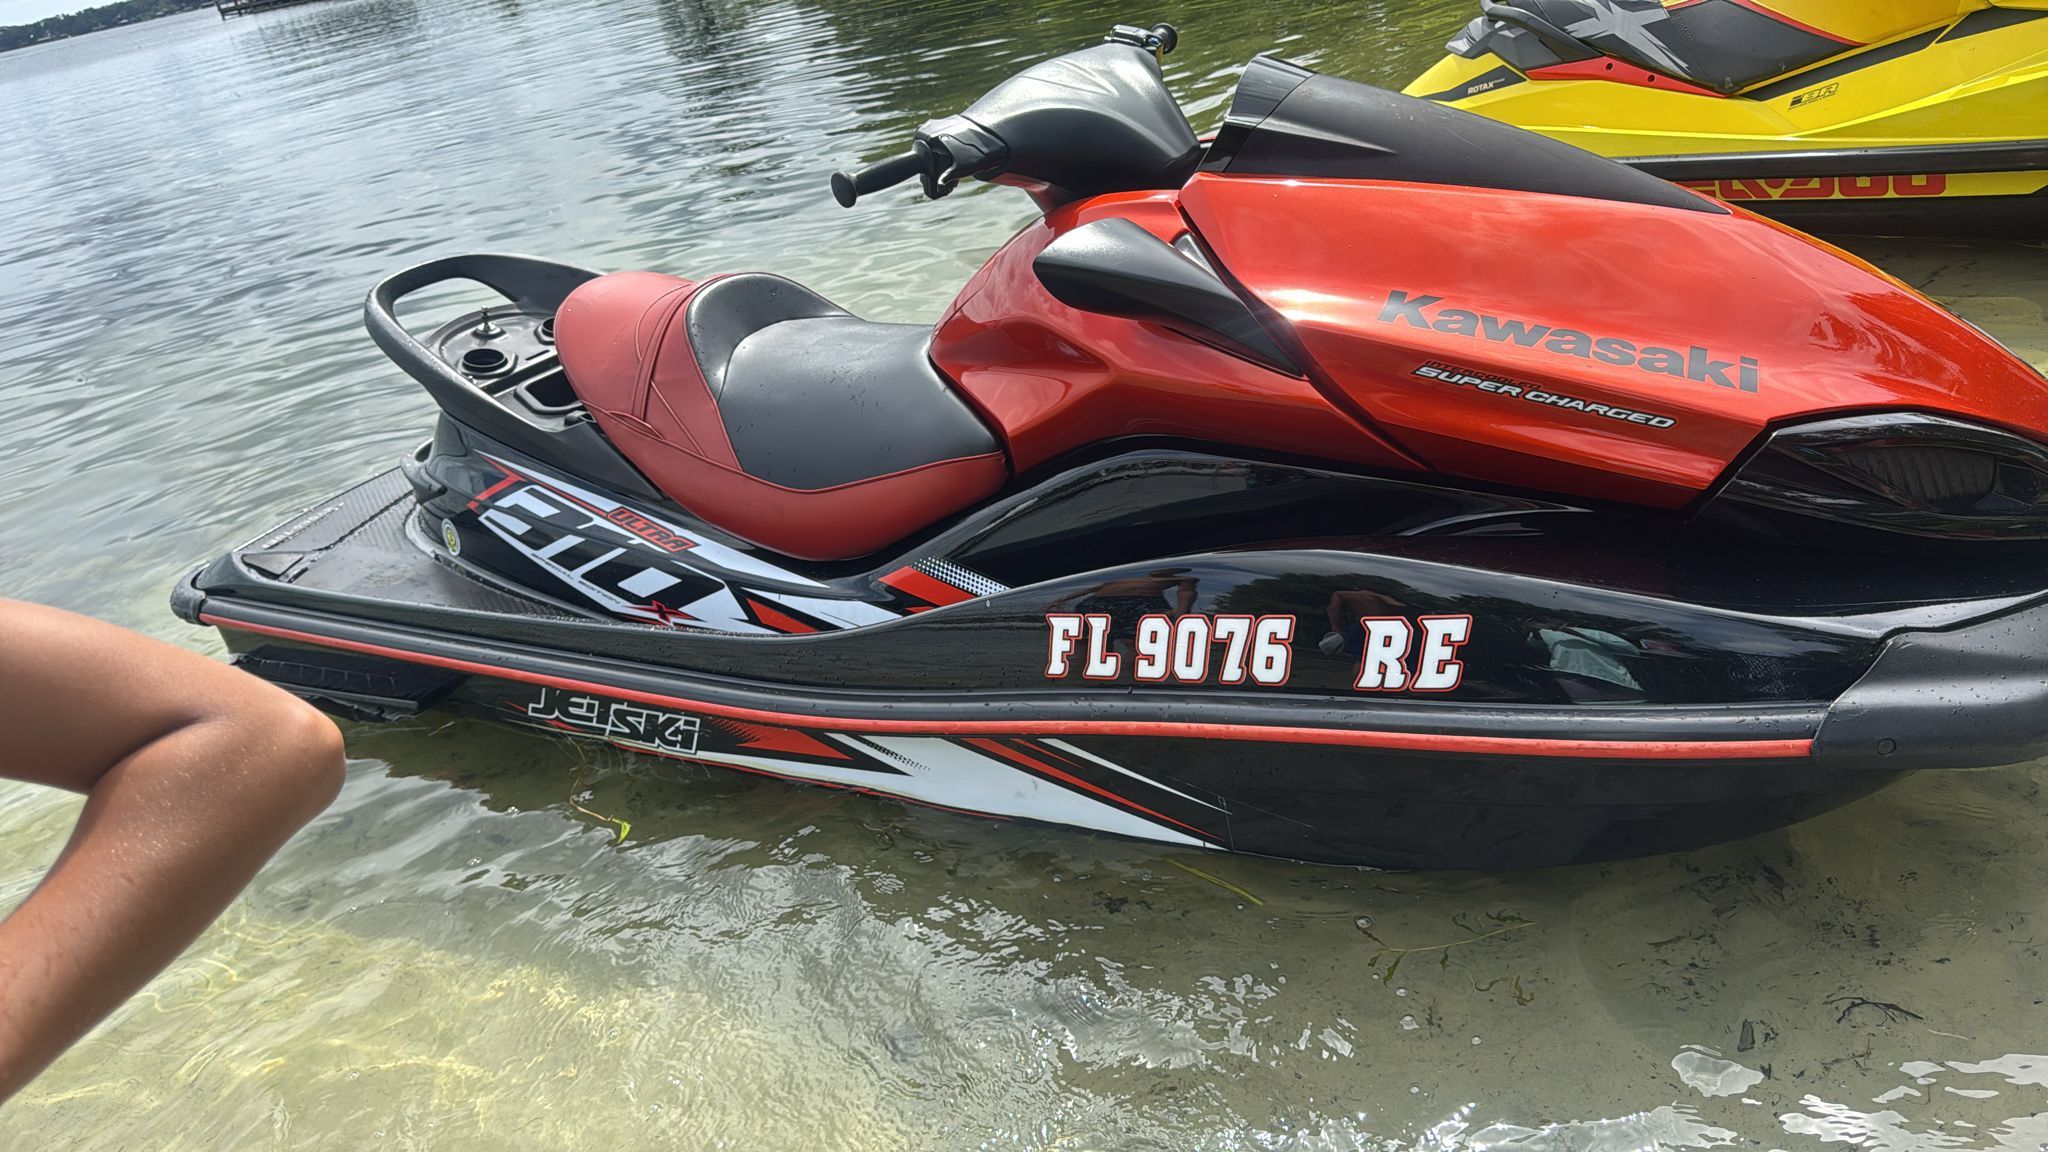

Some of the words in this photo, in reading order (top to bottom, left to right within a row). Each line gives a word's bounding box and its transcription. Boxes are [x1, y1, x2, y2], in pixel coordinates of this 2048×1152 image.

[1467, 80, 1495, 95] ROTAX
[1377, 289, 1760, 394] Kawasaki
[1415, 365, 1523, 398] SUPER
[1523, 390, 1676, 429] CHARGED
[609, 507, 698, 552] ULTRA
[1045, 614, 1121, 680] FL
[1134, 614, 1296, 687] 9076
[1353, 615, 1474, 692] RE
